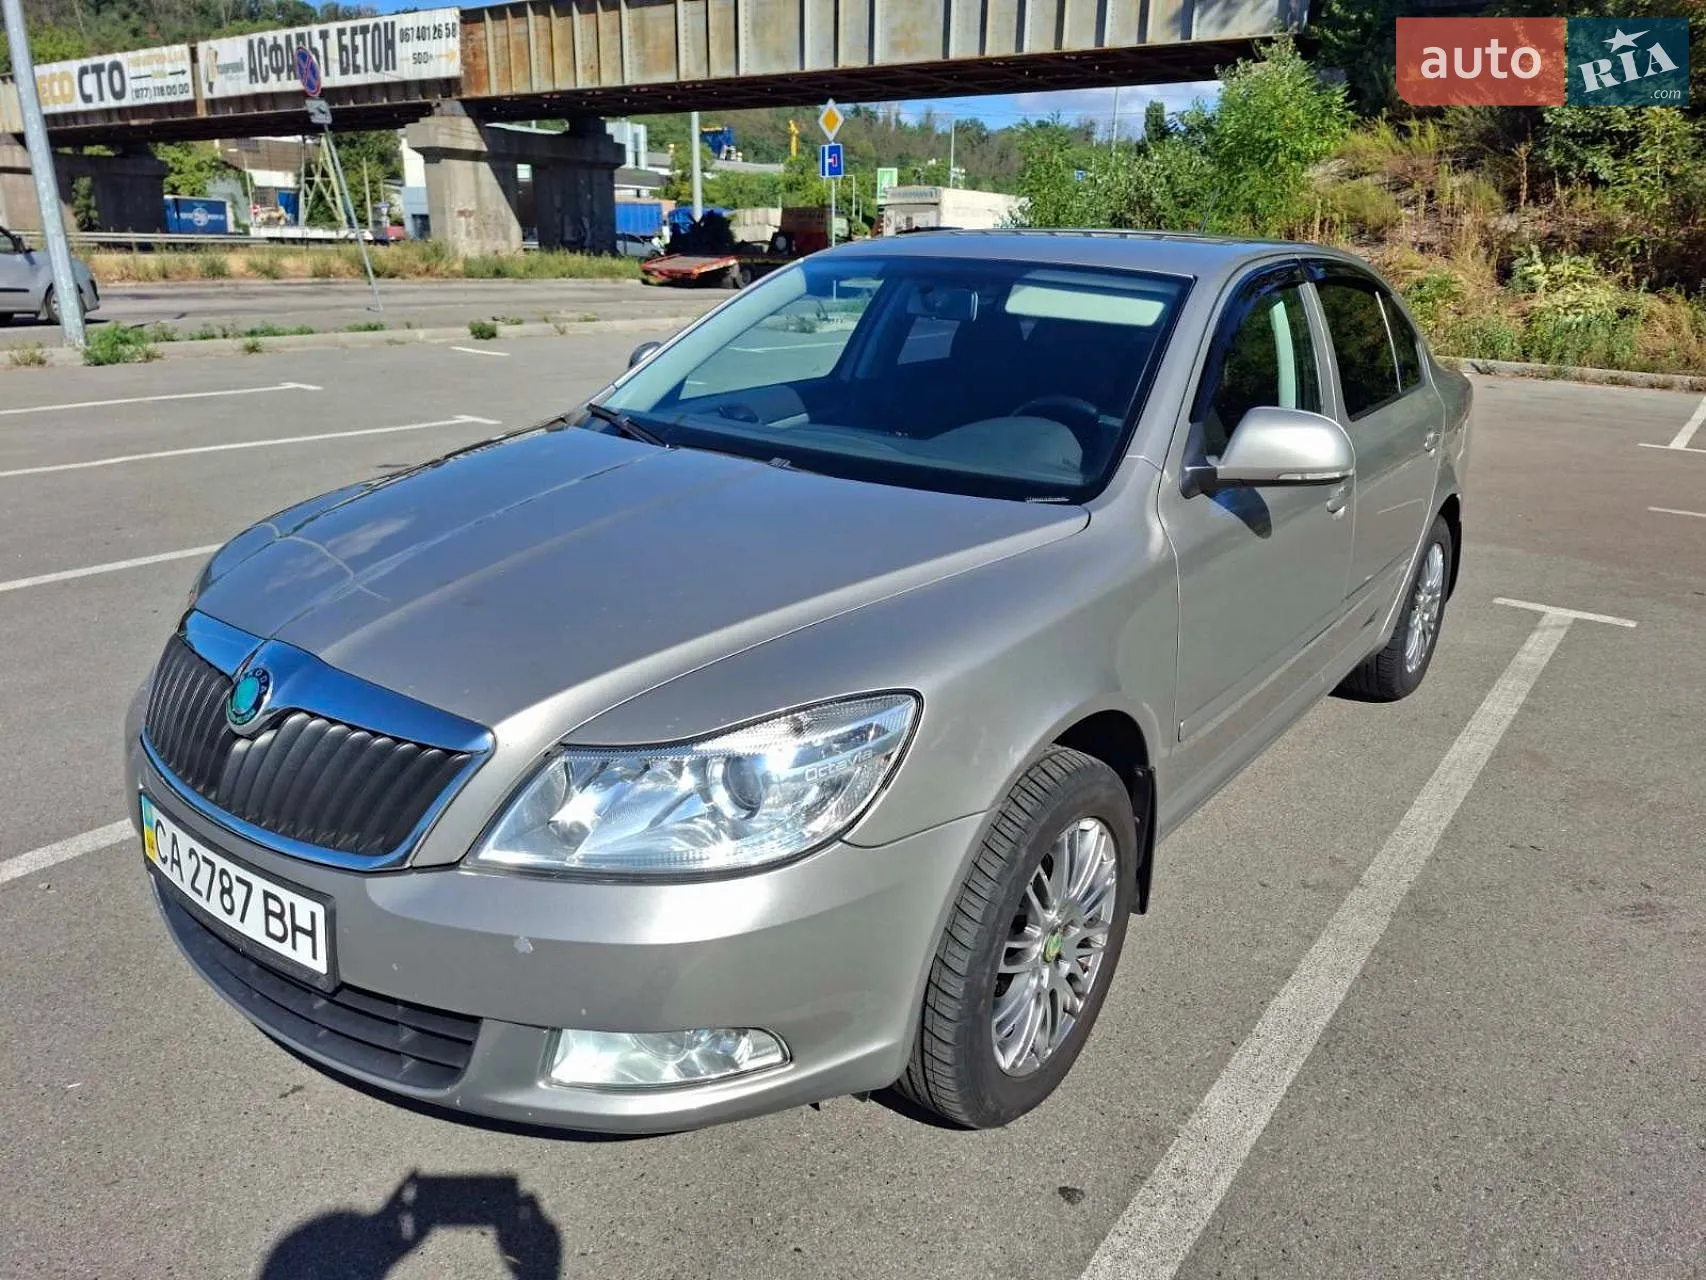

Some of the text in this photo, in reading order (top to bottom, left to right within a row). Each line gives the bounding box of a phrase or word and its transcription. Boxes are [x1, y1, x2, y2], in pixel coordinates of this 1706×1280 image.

[337, 21, 397, 76] БЕТОН
[78, 60, 126, 104] СТО
[155, 819, 317, 961] CA 2787 BH
